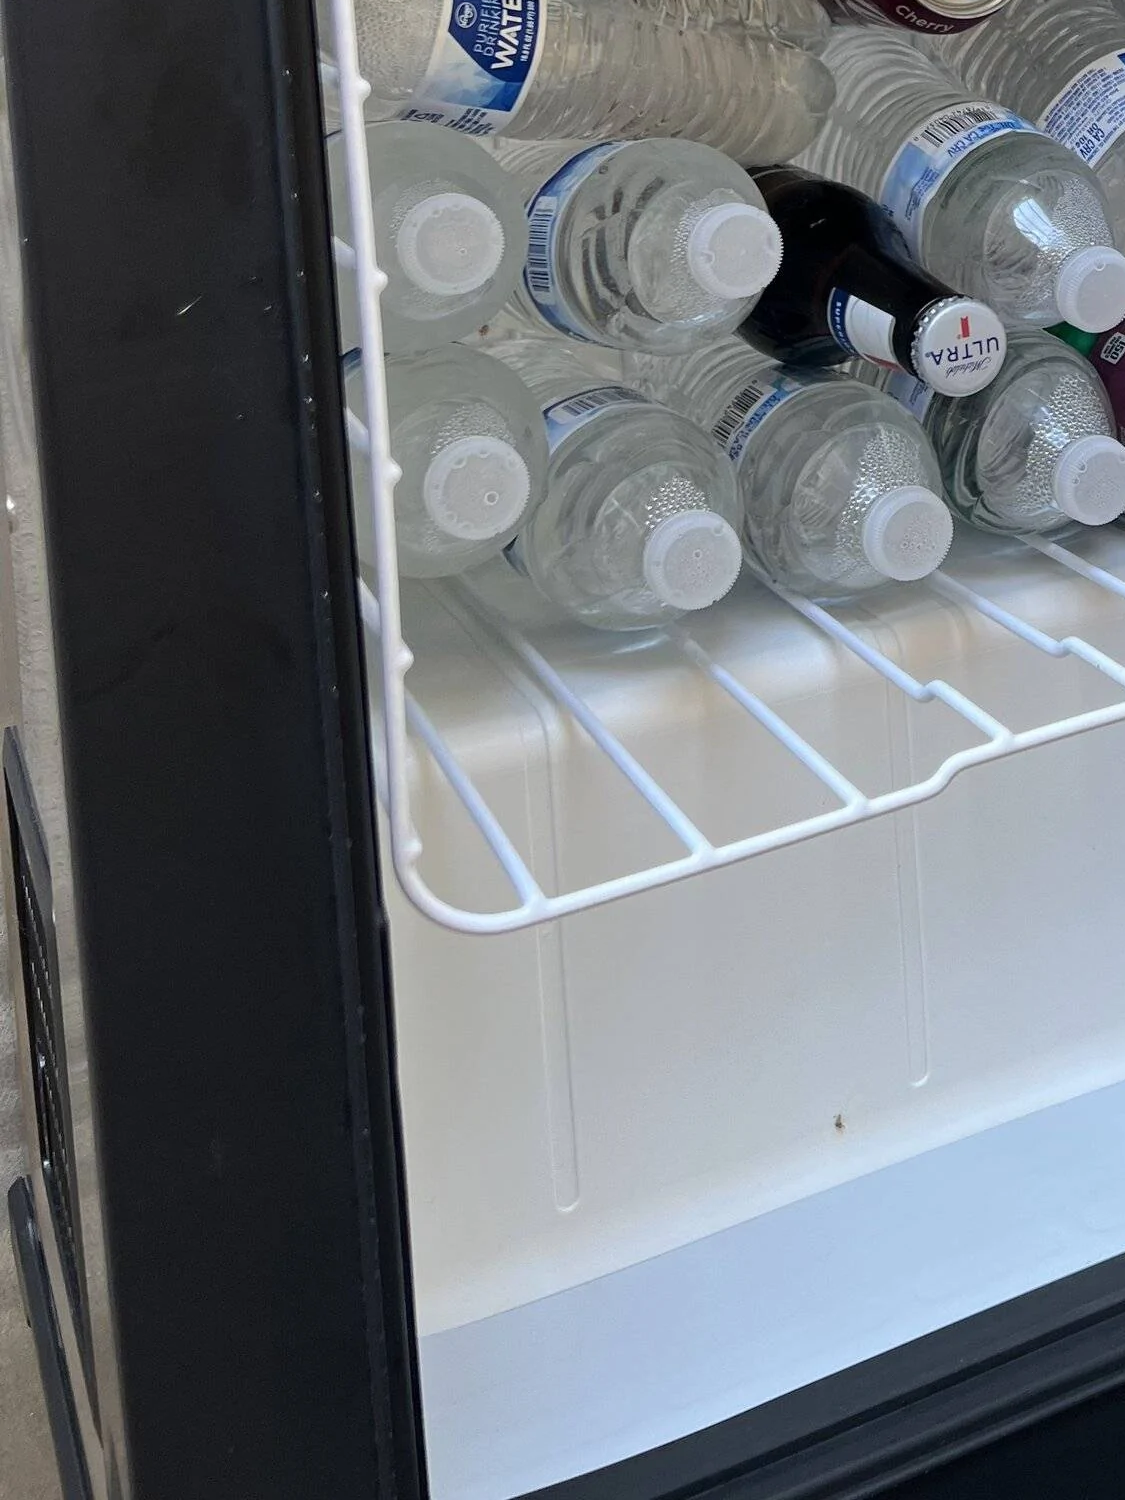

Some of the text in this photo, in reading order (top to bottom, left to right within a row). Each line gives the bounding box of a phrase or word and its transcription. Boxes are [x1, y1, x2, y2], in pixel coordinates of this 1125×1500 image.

[895, 4, 954, 33] Cherry
[1086, 122, 1099, 135] OR
[1078, 128, 1106, 159] CA CRV
[930, 337, 999, 365] ULTRA
